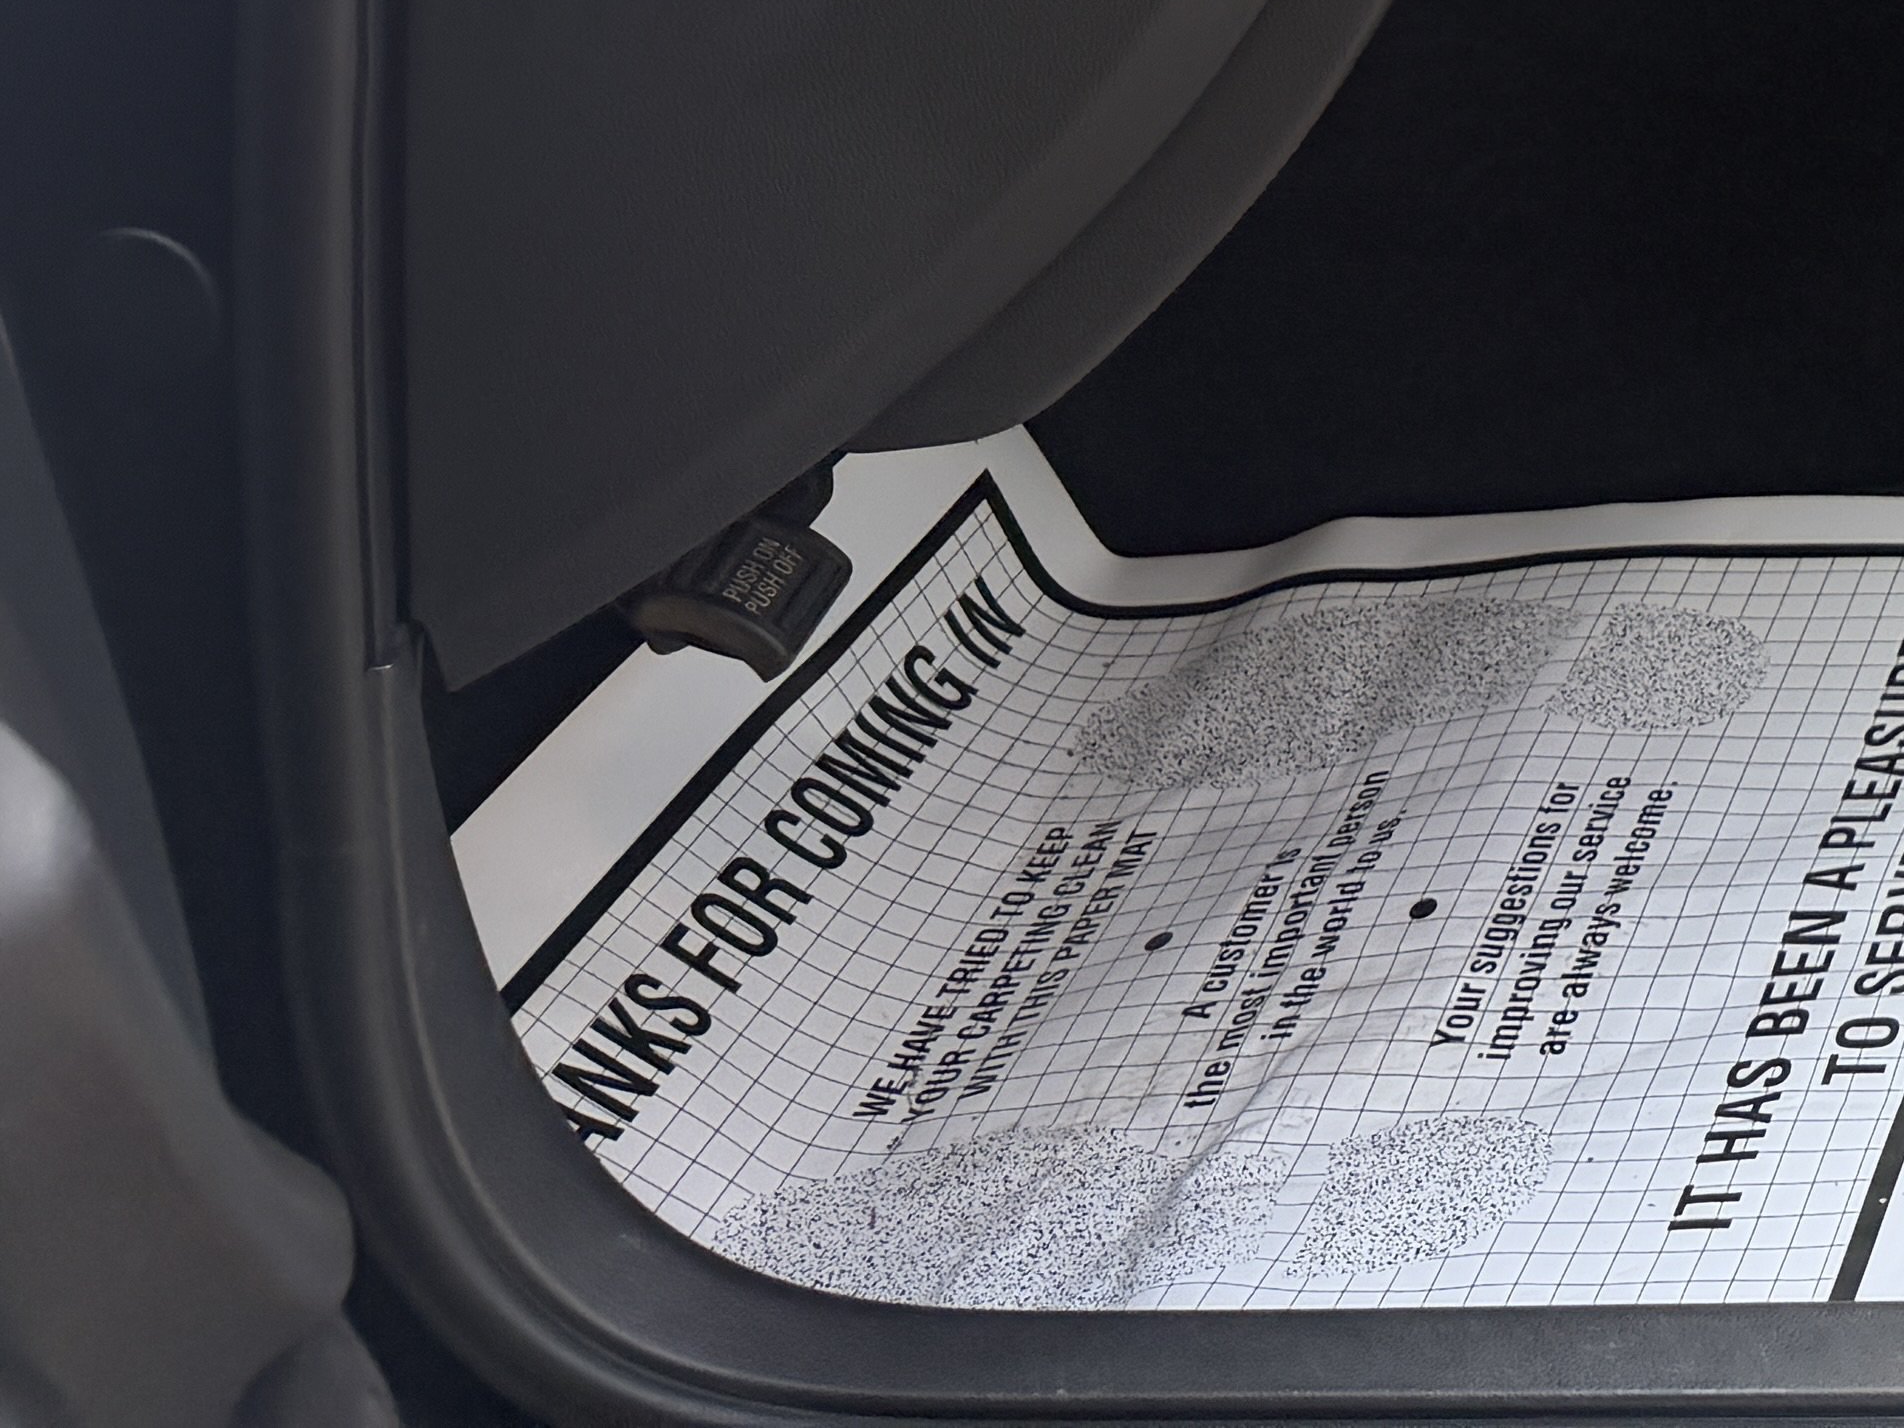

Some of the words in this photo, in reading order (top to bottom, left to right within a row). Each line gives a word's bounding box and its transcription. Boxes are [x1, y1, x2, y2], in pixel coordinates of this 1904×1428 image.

[722, 559, 765, 603] PUSH
[753, 537, 781, 560] ON
[745, 571, 785, 615] PUSH
[772, 545, 803, 575] OFF
[660, 856, 815, 994] FOR
[764, 645, 979, 869] COMING
[944, 577, 1026, 669] IN
[1802, 862, 1866, 892] A
[853, 1076, 909, 1117] WE
[887, 1005, 954, 1071] HAVE
[936, 927, 1010, 999] TRIED
[990, 890, 1036, 920] TO
[1016, 826, 1075, 883] KEEP
[901, 1048, 976, 1123] YOUR
[956, 903, 1073, 1041] CARPETING
[1053, 818, 1123, 896] CLEAN
[958, 1030, 1028, 1101] WITH
[1008, 968, 1070, 1027] THIS
[1050, 885, 1121, 964] PAPER
[1105, 830, 1158, 881] MAT
[1181, 1000, 1219, 1020] A
[1200, 872, 1285, 994] customer
[1266, 847, 1302, 868] is
[1183, 1059, 1232, 1108] the
[1217, 983, 1272, 1052] most
[1250, 853, 1342, 978] important
[1326, 770, 1390, 848] person
[1260, 1013, 1299, 1040] in
[1280, 966, 1325, 1007] the
[1312, 881, 1366, 960] world
[1346, 849, 1383, 878] to
[1429, 982, 1487, 1048] Your
[1470, 820, 1562, 974] suggestions
[1539, 782, 1580, 814] for
[1477, 919, 1572, 1061] improving
[1551, 870, 1589, 911] our
[1573, 776, 1632, 862] service
[1539, 1008, 1579, 1056] are
[1561, 902, 1622, 999] always
[1604, 781, 1679, 896] welcome.
[1745, 909, 1849, 1041] BEEN
[1696, 1057, 1791, 1165] HAS
[1822, 1015, 1902, 1087] TO
[1667, 1184, 1743, 1232] IT
